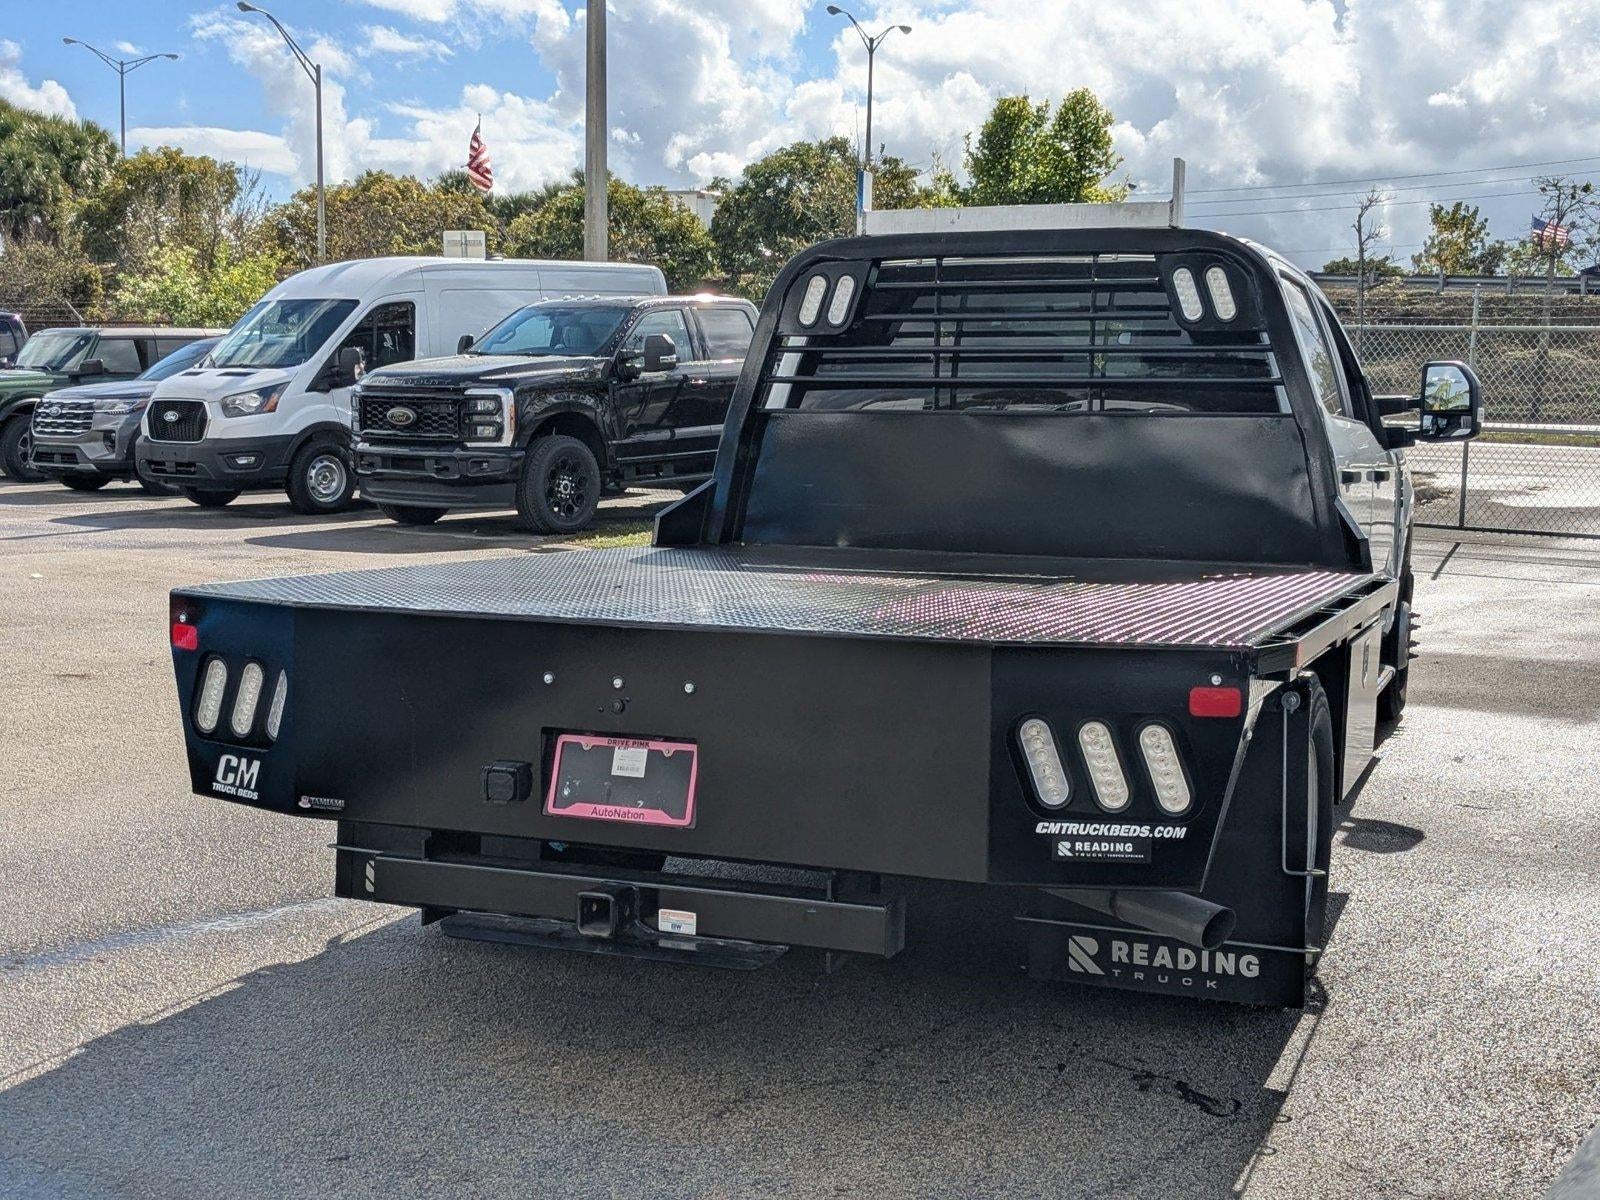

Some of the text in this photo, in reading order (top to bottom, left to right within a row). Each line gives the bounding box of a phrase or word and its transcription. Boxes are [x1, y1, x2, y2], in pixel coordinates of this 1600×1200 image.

[608, 739, 630, 747] DRIVE
[216, 754, 261, 790] CM
[212, 782, 259, 801] TRUCK BEDS
[591, 807, 644, 821] AutoNation
[1035, 822, 1188, 839] CMTRUCKBEDS.COM
[1075, 841, 1134, 852] READING
[1111, 940, 1260, 978] READING
[1112, 969, 1218, 989] TRUCK
